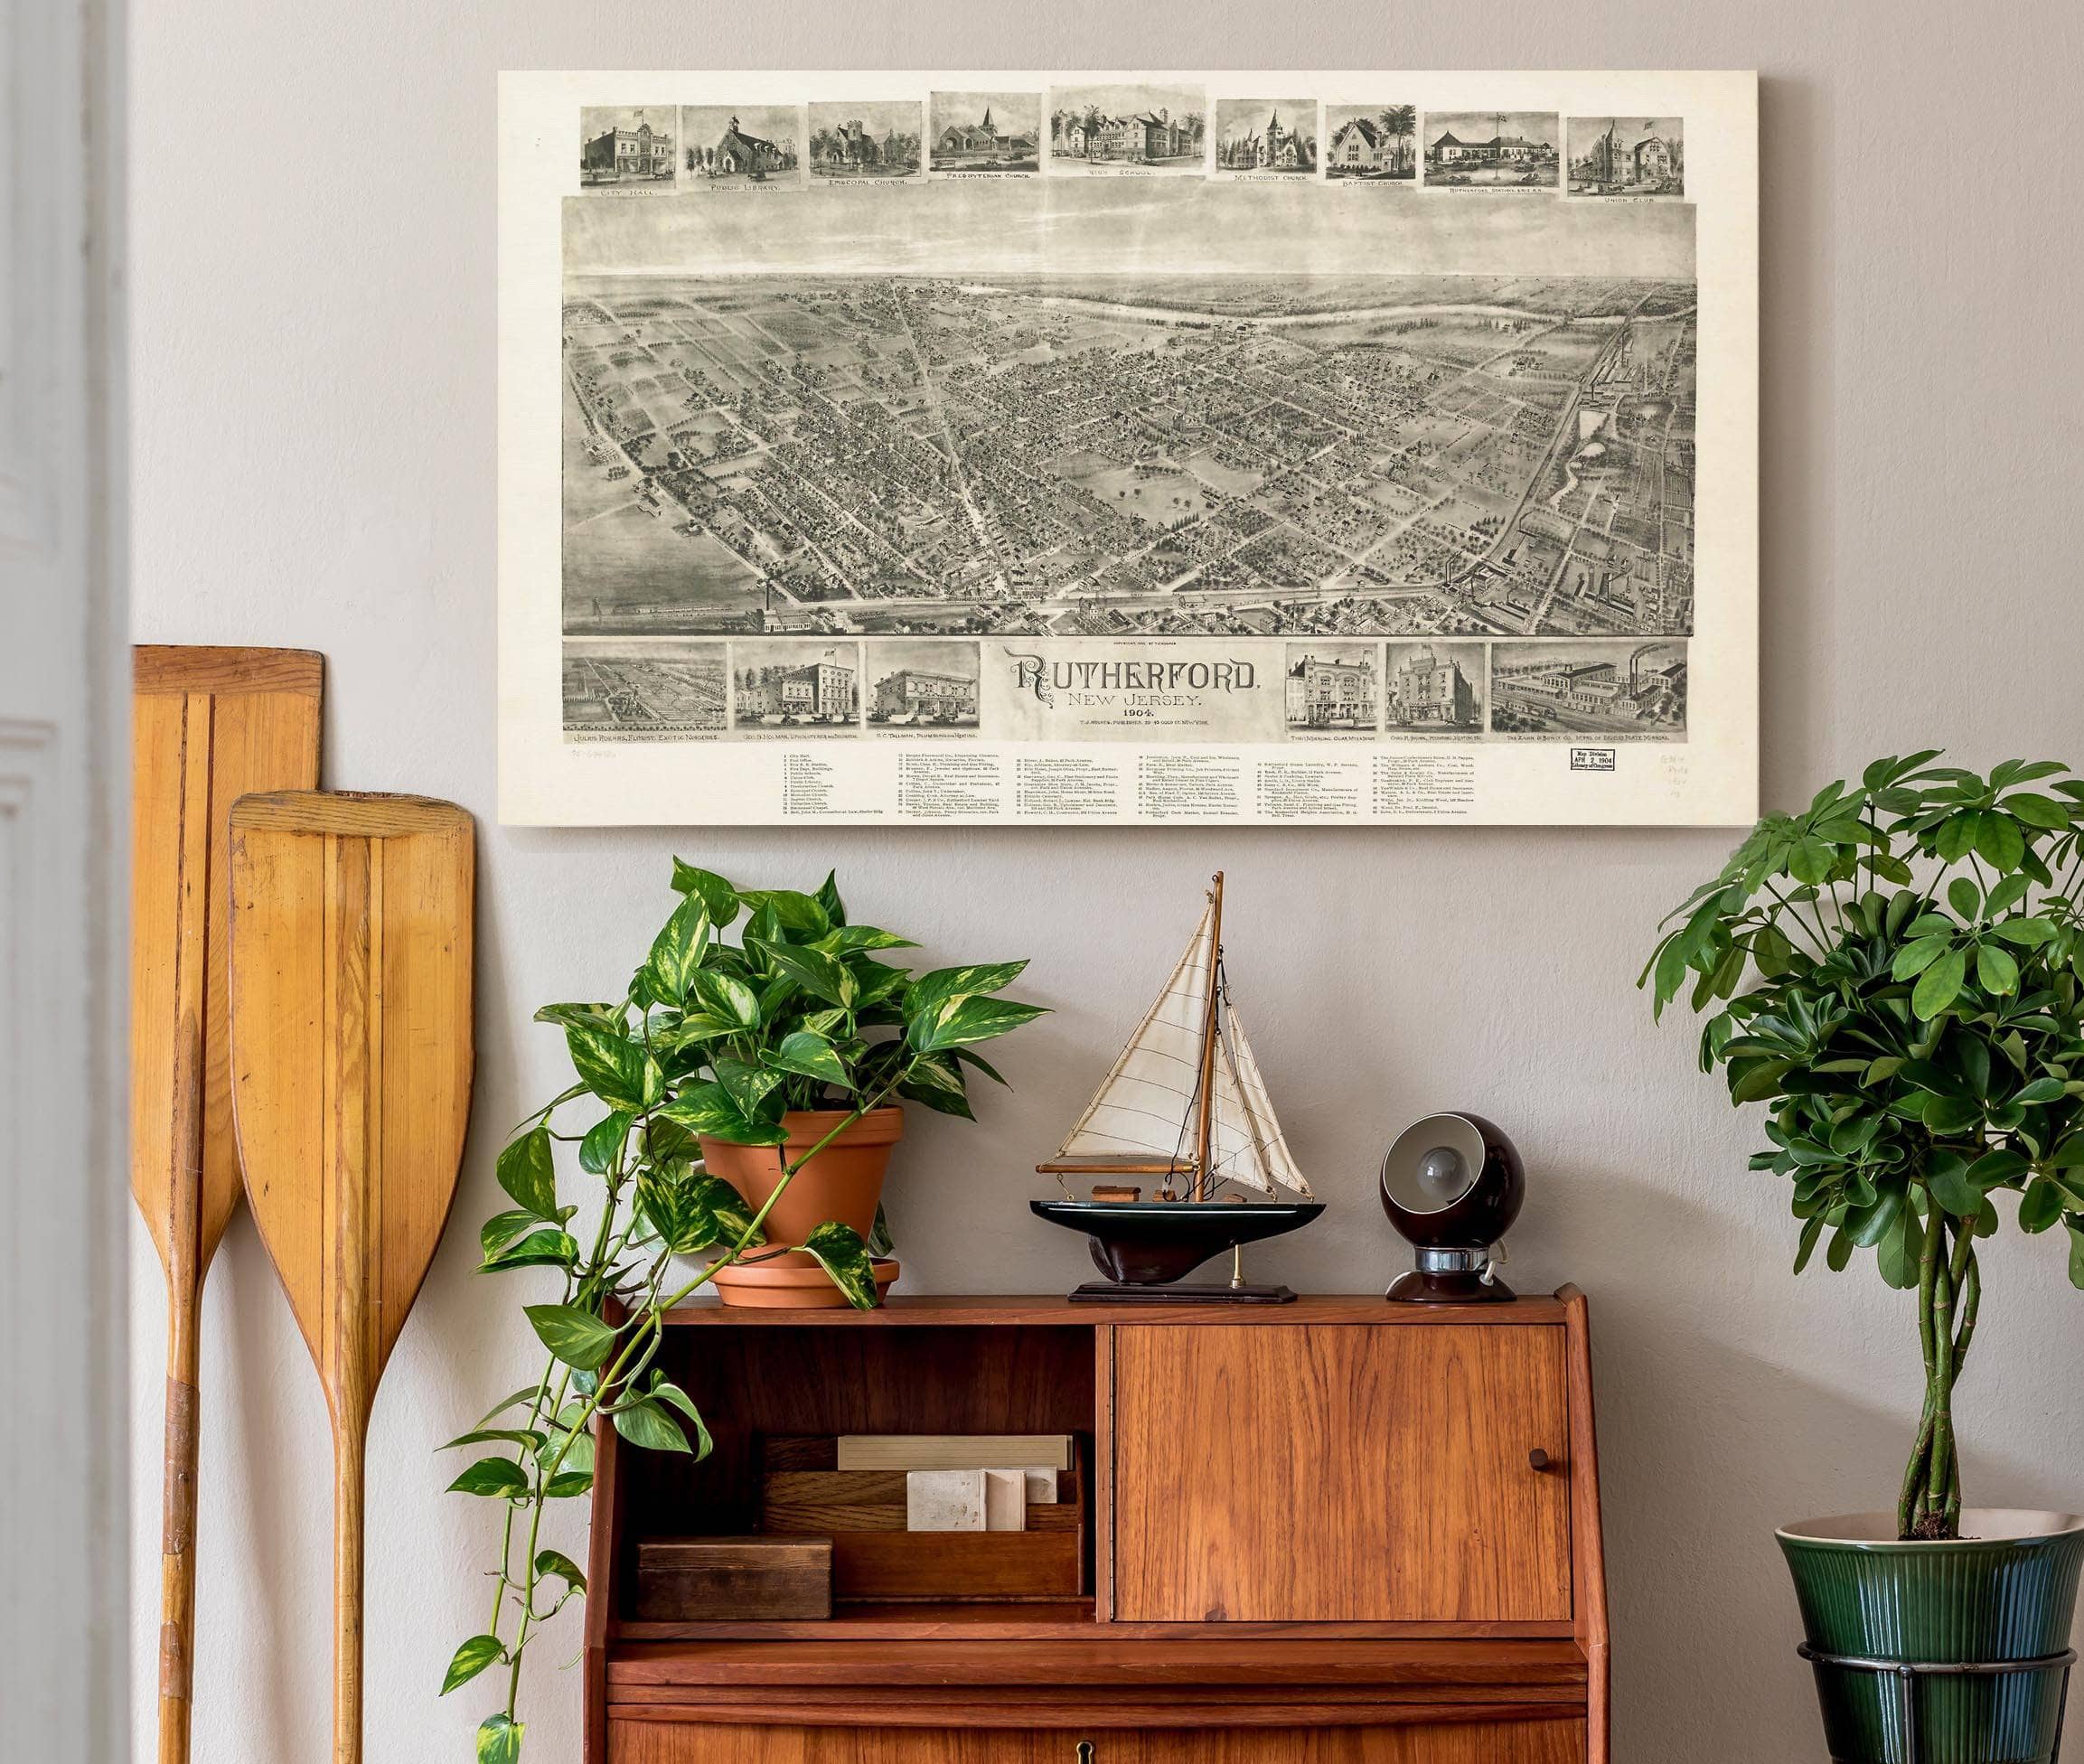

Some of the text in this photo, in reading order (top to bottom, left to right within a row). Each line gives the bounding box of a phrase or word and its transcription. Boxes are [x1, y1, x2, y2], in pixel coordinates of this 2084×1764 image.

[709, 183, 740, 192] PUBLIC
[1004, 646, 1261, 709] RUTHERFORD.
[1068, 692, 1203, 706] NEW JERSEY.
[1123, 708, 1155, 718] 1904.
